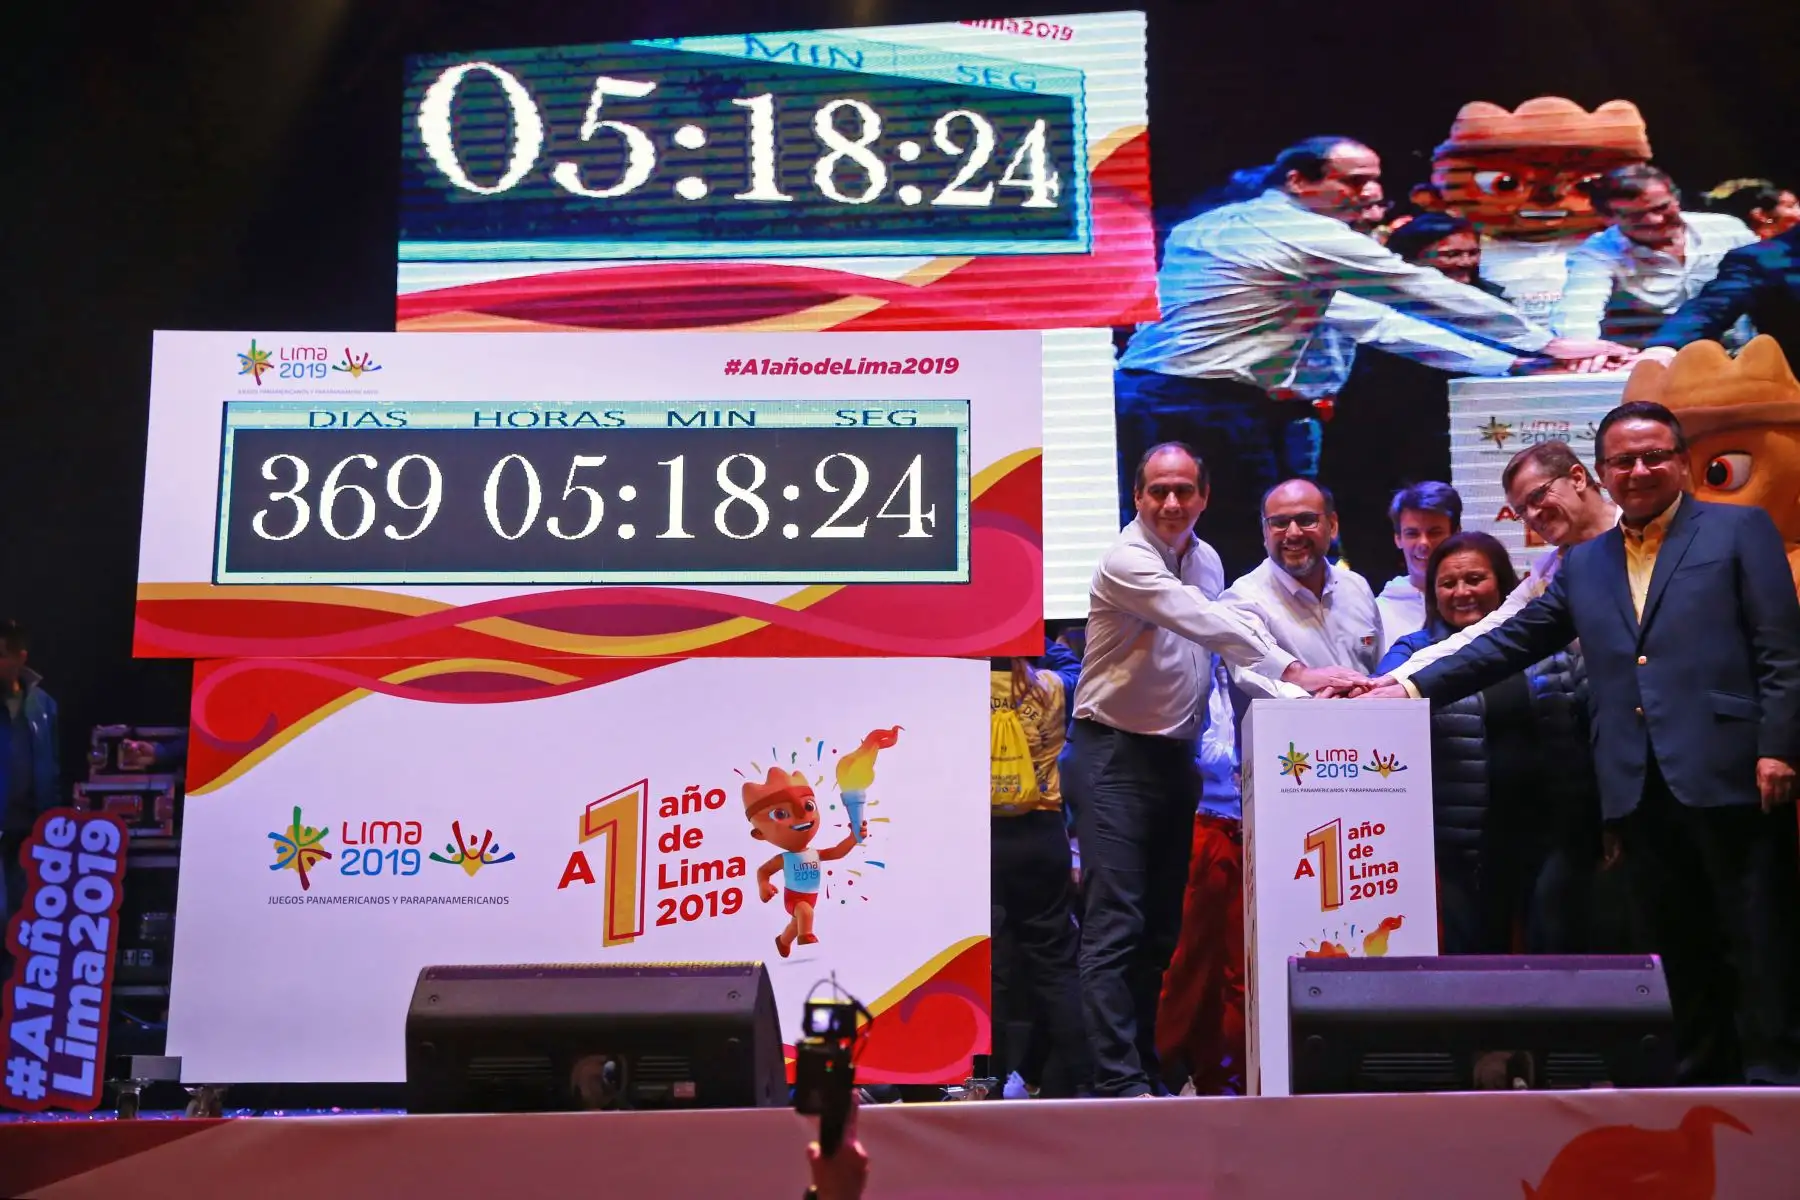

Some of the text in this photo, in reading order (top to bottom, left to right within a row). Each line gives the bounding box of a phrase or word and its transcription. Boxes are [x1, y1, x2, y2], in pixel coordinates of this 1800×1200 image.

[744, 33, 1037, 92] MIN SEG
[416, 61, 1060, 208] 05:18:24
[279, 362, 327, 379] 2019
[724, 357, 959, 376] #A1añodeLima2019
[308, 409, 917, 428] DIAS HORAS MIN SEG
[252, 452, 937, 541] 369 05:18:24
[1316, 763, 1359, 778] 2019
[658, 785, 727, 818] año
[658, 824, 704, 853] de
[1347, 822, 1386, 840] año
[340, 848, 421, 876] 2019
[557, 778, 649, 948] A 1
[1294, 818, 1344, 912] A 1
[1348, 843, 1374, 860] de
[658, 856, 746, 890] Lima
[795, 869, 819, 881] 2019
[1349, 859, 1399, 880] Lima
[268, 896, 510, 905] JUEGOS PANAMERICANOS Y PARAPANAMERICANOS
[1349, 878, 1398, 900] 2019
[656, 887, 744, 927] 2019
[6, 816, 78, 1101] #A1añode
[53, 818, 122, 1098] Lima2019
